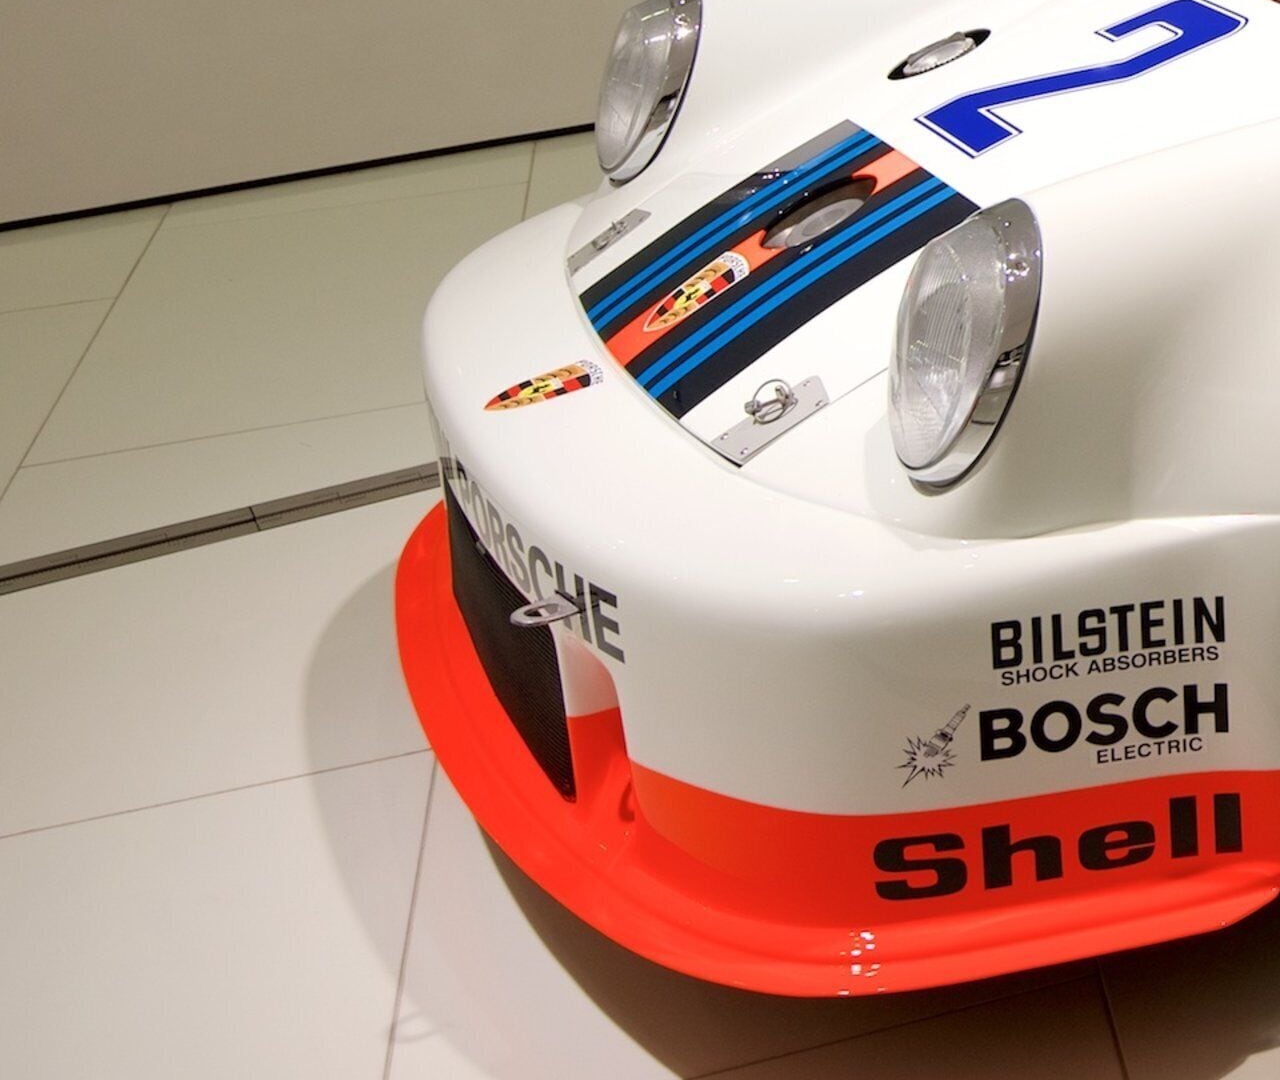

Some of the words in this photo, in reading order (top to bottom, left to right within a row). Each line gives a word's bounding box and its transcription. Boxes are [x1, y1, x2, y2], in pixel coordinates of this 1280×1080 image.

[990, 596, 1226, 670] BILSTEIN
[1001, 663, 1080, 686] SHOCK
[1086, 647, 1220, 675] ABSORBERS
[979, 684, 1229, 762] BOSCH
[1096, 736, 1204, 763] ELECTRIC
[873, 793, 1244, 901] Shell
